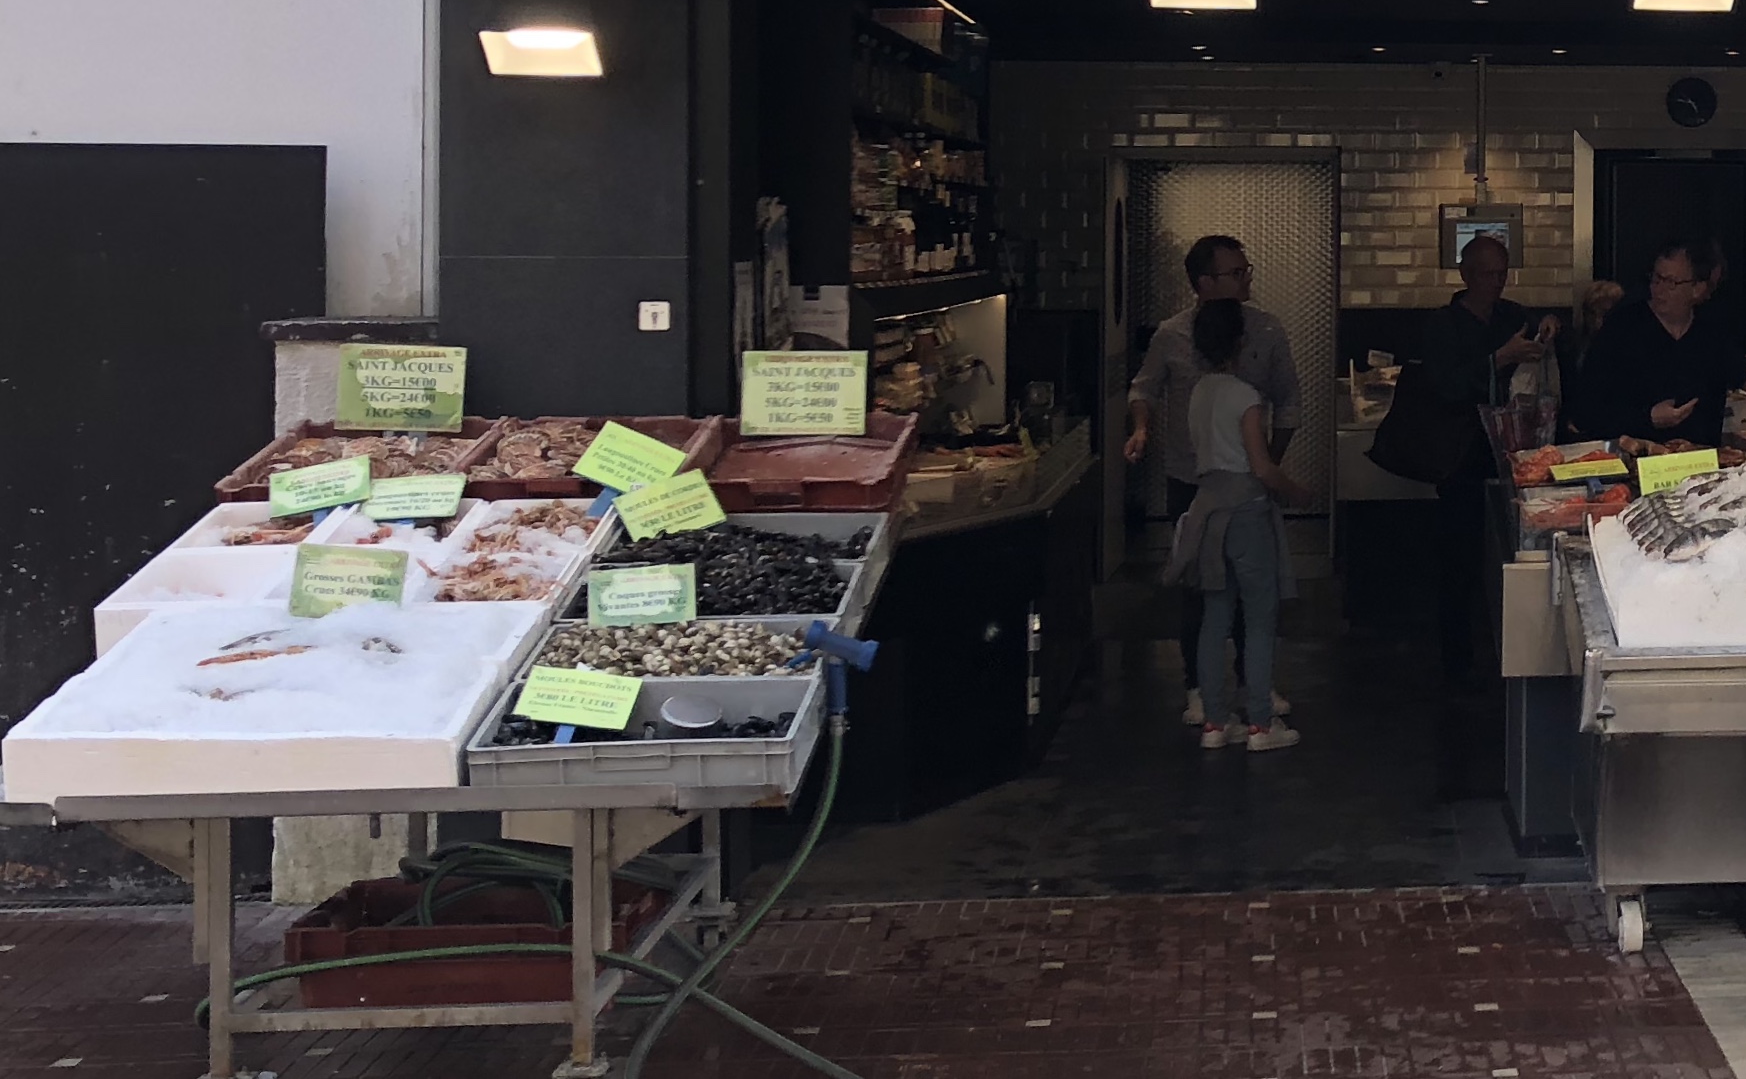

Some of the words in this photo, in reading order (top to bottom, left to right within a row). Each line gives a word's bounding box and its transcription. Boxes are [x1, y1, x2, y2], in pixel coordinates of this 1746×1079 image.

[347, 360, 387, 370] SAINT
[391, 361, 455, 373] JACQUES
[579, 696, 617, 709] LITRE
